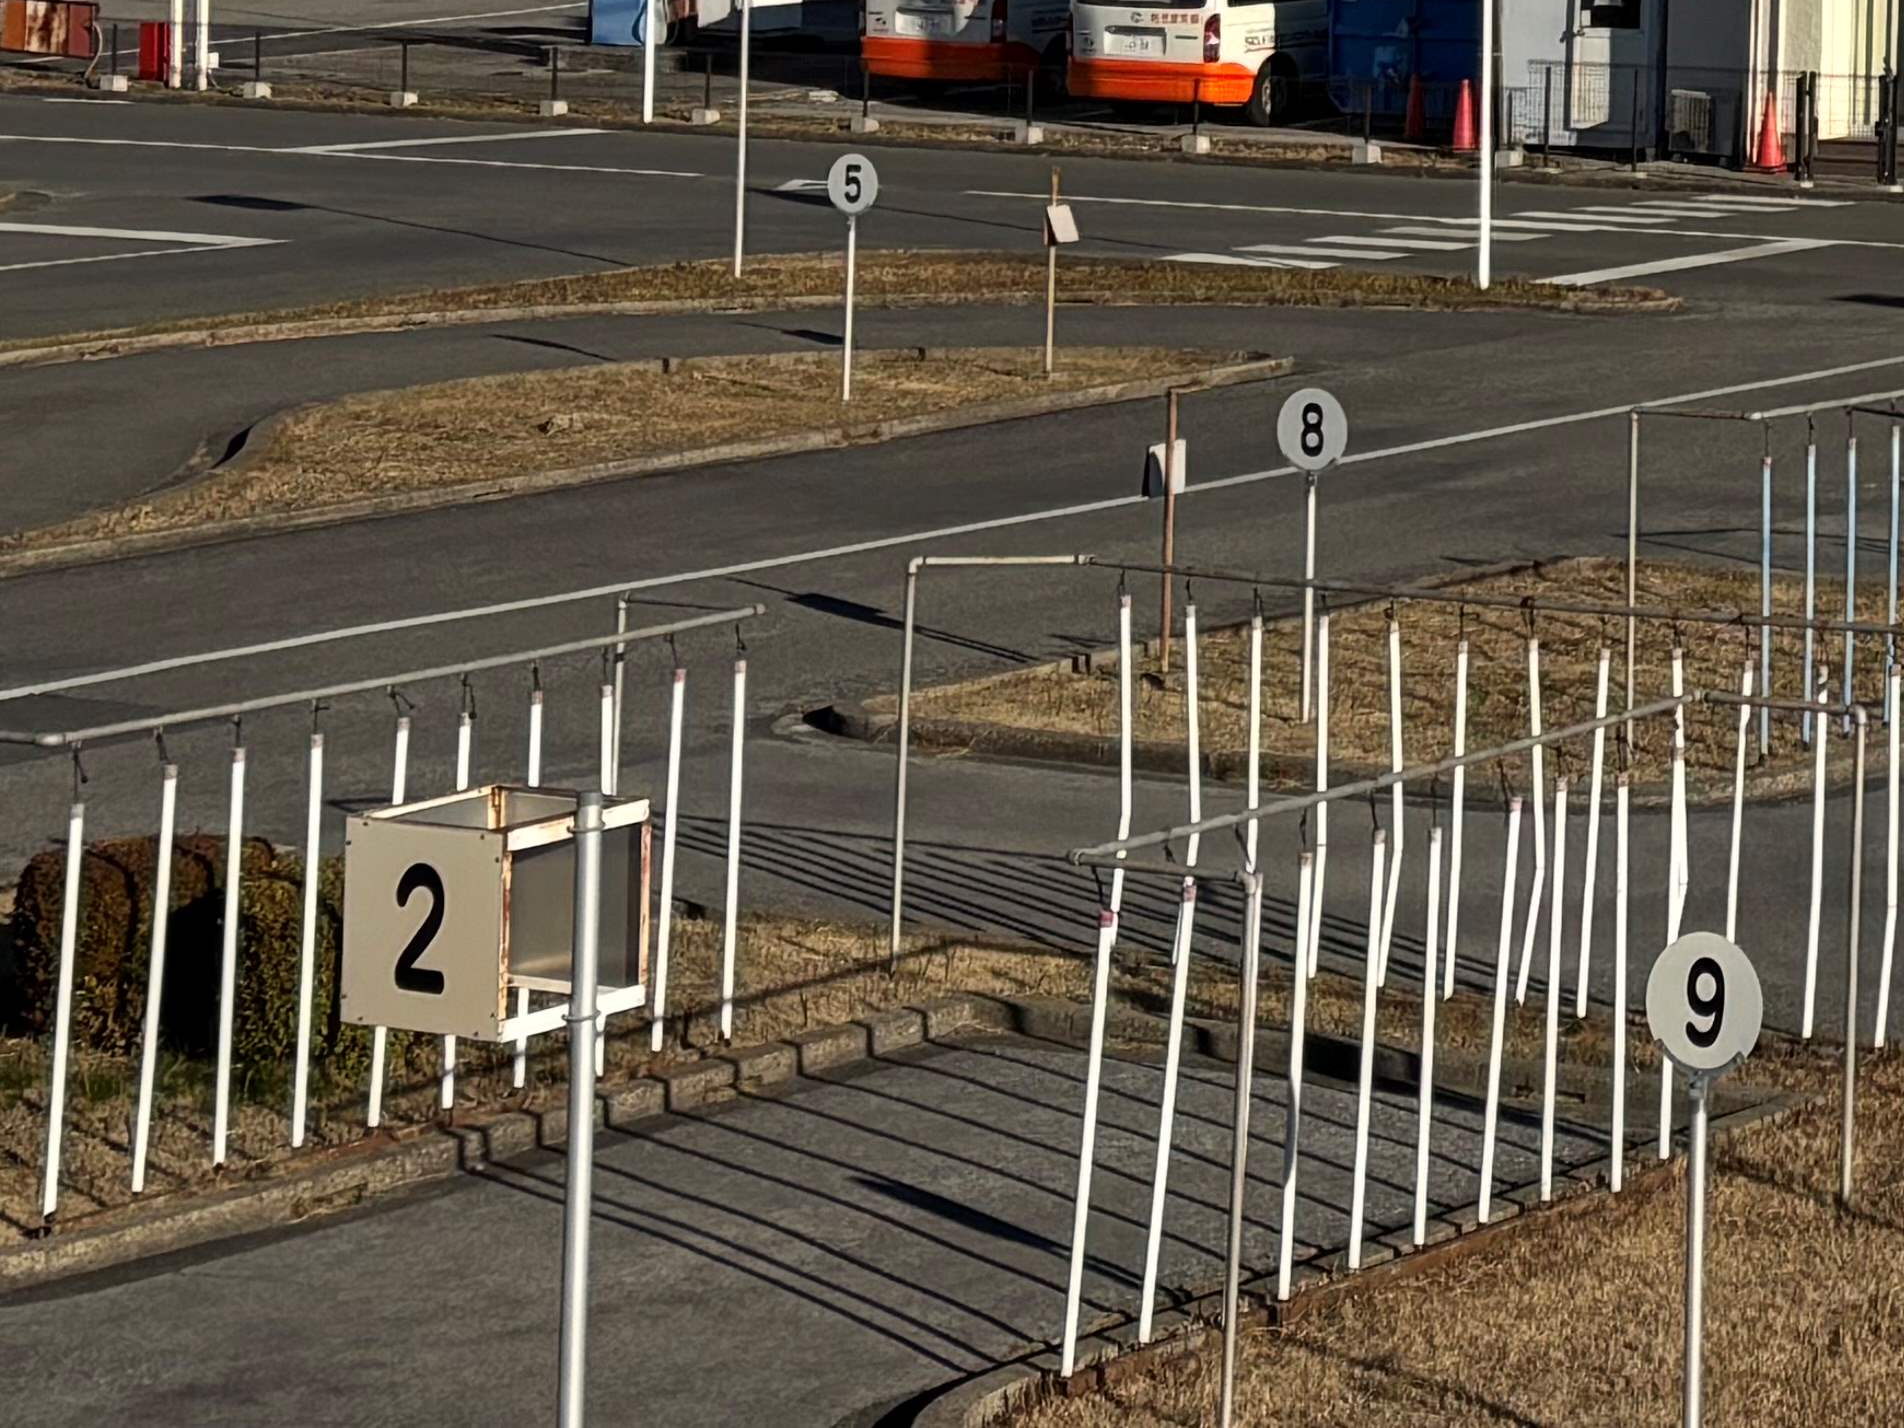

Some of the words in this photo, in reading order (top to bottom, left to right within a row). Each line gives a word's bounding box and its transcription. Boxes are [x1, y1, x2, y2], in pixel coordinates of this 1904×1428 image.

[844, 164, 862, 204] 5
[1300, 402, 1324, 458] 8
[394, 862, 445, 995] 2
[1686, 956, 1726, 1048] 9
